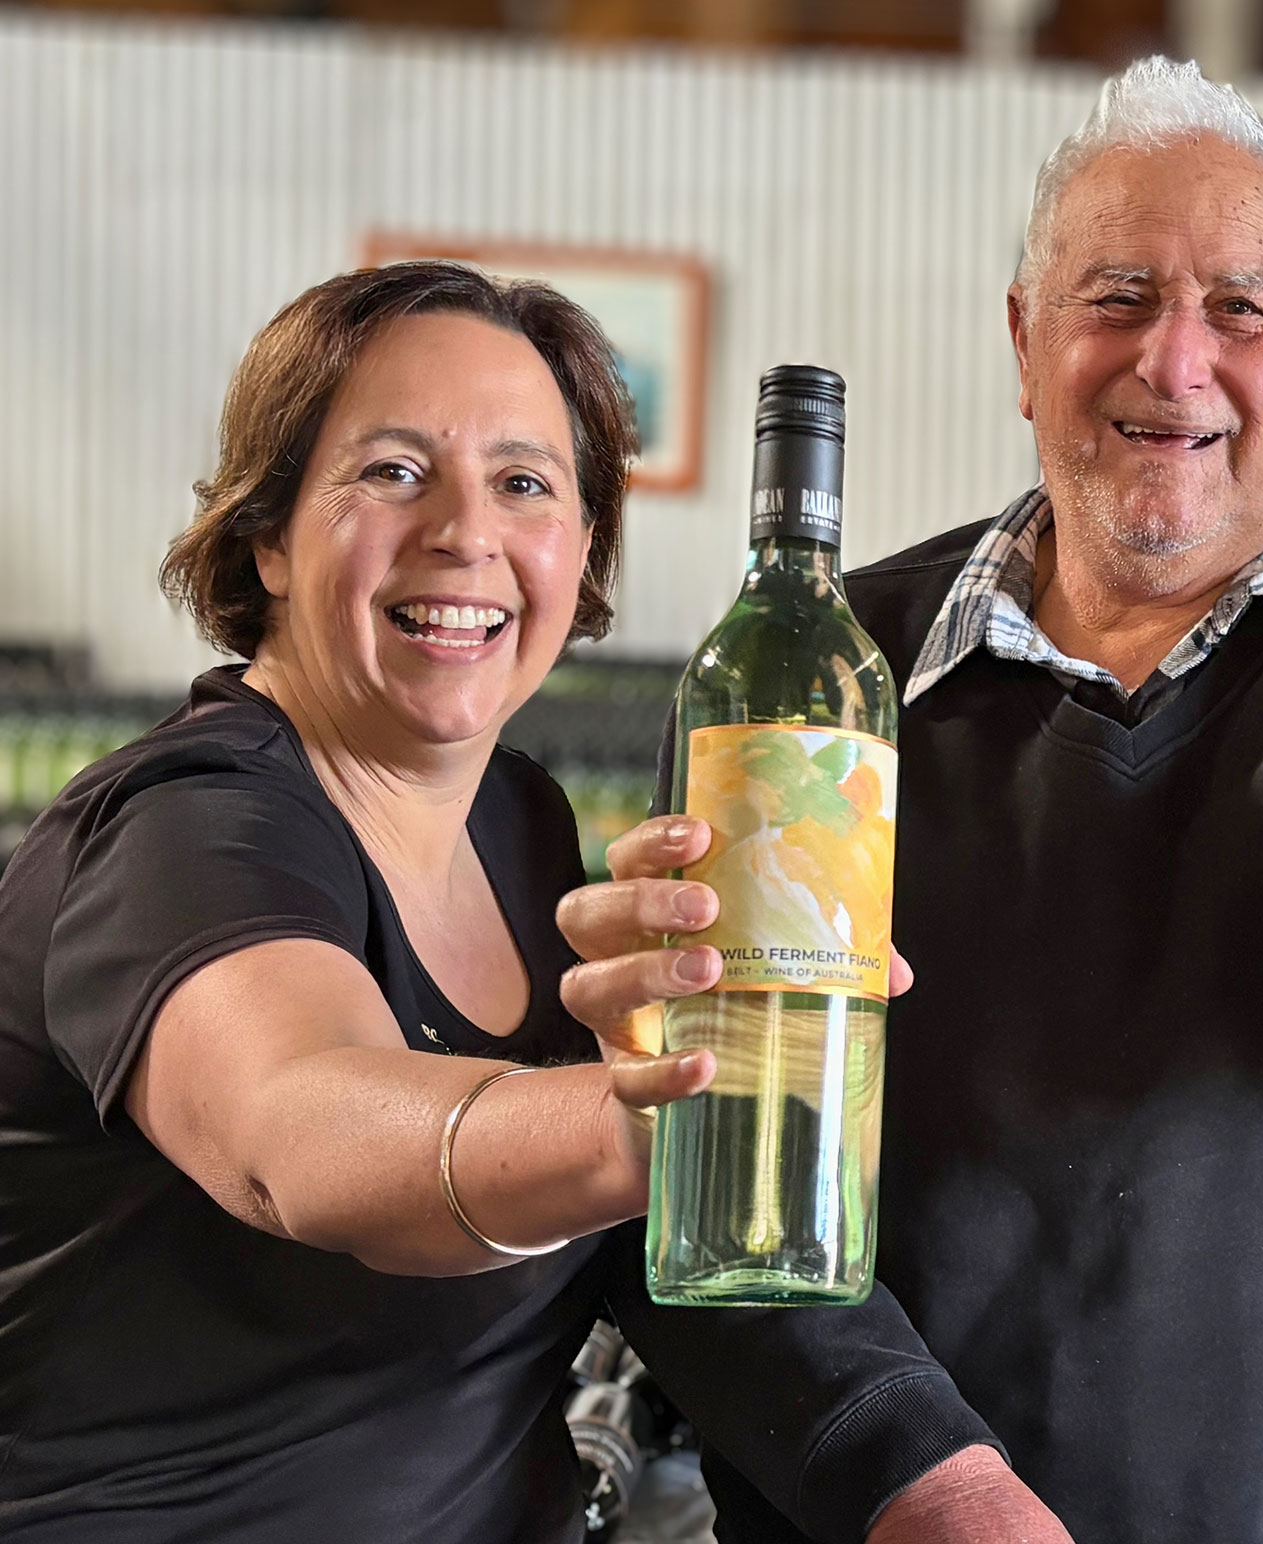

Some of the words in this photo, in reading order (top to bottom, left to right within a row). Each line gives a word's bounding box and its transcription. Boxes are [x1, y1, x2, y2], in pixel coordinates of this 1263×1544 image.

[722, 948, 764, 960] WILD
[769, 948, 846, 964] FERMENT
[849, 955, 881, 970] FIANO
[764, 967, 794, 977] WINE
[795, 968, 811, 977] OF
[814, 968, 864, 981] AUSTRALIA
